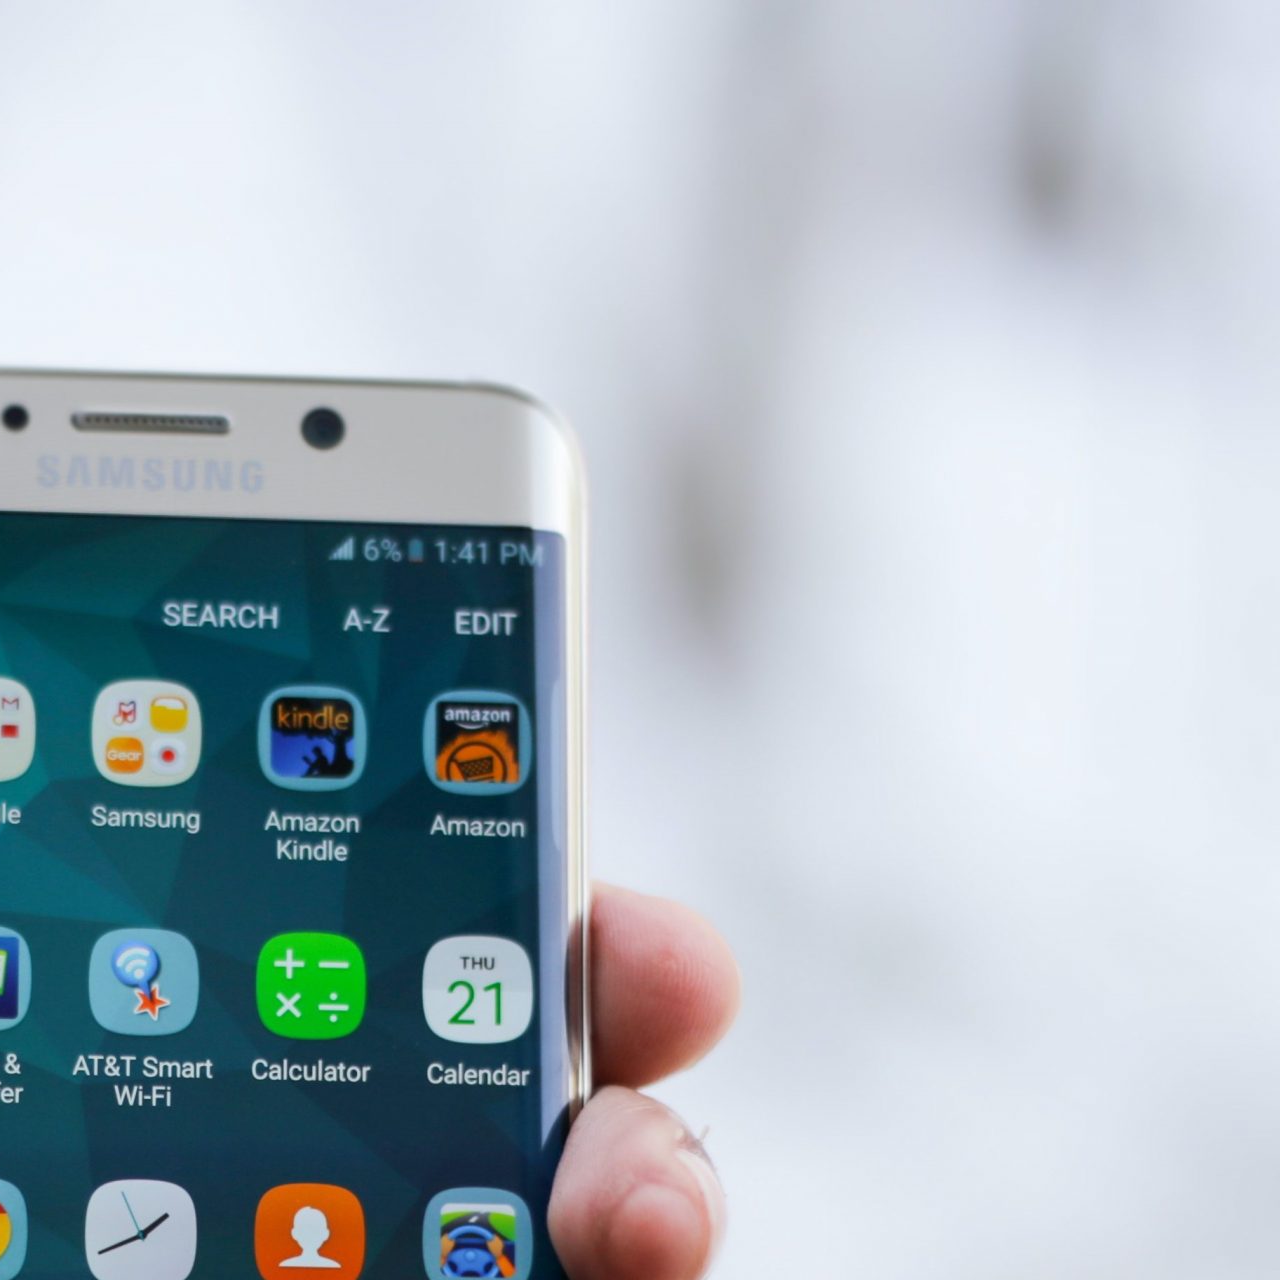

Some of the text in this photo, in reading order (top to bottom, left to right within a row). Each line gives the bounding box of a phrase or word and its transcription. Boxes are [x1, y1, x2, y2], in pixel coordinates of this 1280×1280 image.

[37, 453, 266, 493] SAMSUNG
[364, 538, 402, 562] 6%
[434, 541, 544, 567] 1:41 PM
[163, 602, 279, 631] SEARCH
[343, 608, 390, 632] A-Z
[454, 610, 517, 635] EDIT
[277, 705, 348, 730] kindle
[444, 707, 511, 724] amazon
[106, 750, 142, 763] Gear
[91, 807, 200, 833] Samsung
[265, 811, 360, 833] Amazon
[430, 816, 525, 837] Amazon
[276, 840, 348, 861] Kindle
[460, 956, 495, 970] THU
[447, 981, 502, 1025] 21
[5, 1053, 20, 1073] &
[73, 1056, 213, 1078] AT&T Smart
[251, 1059, 370, 1082] Calculator
[427, 1063, 529, 1086] Calendar
[114, 1085, 171, 1106] Wi-Fi
